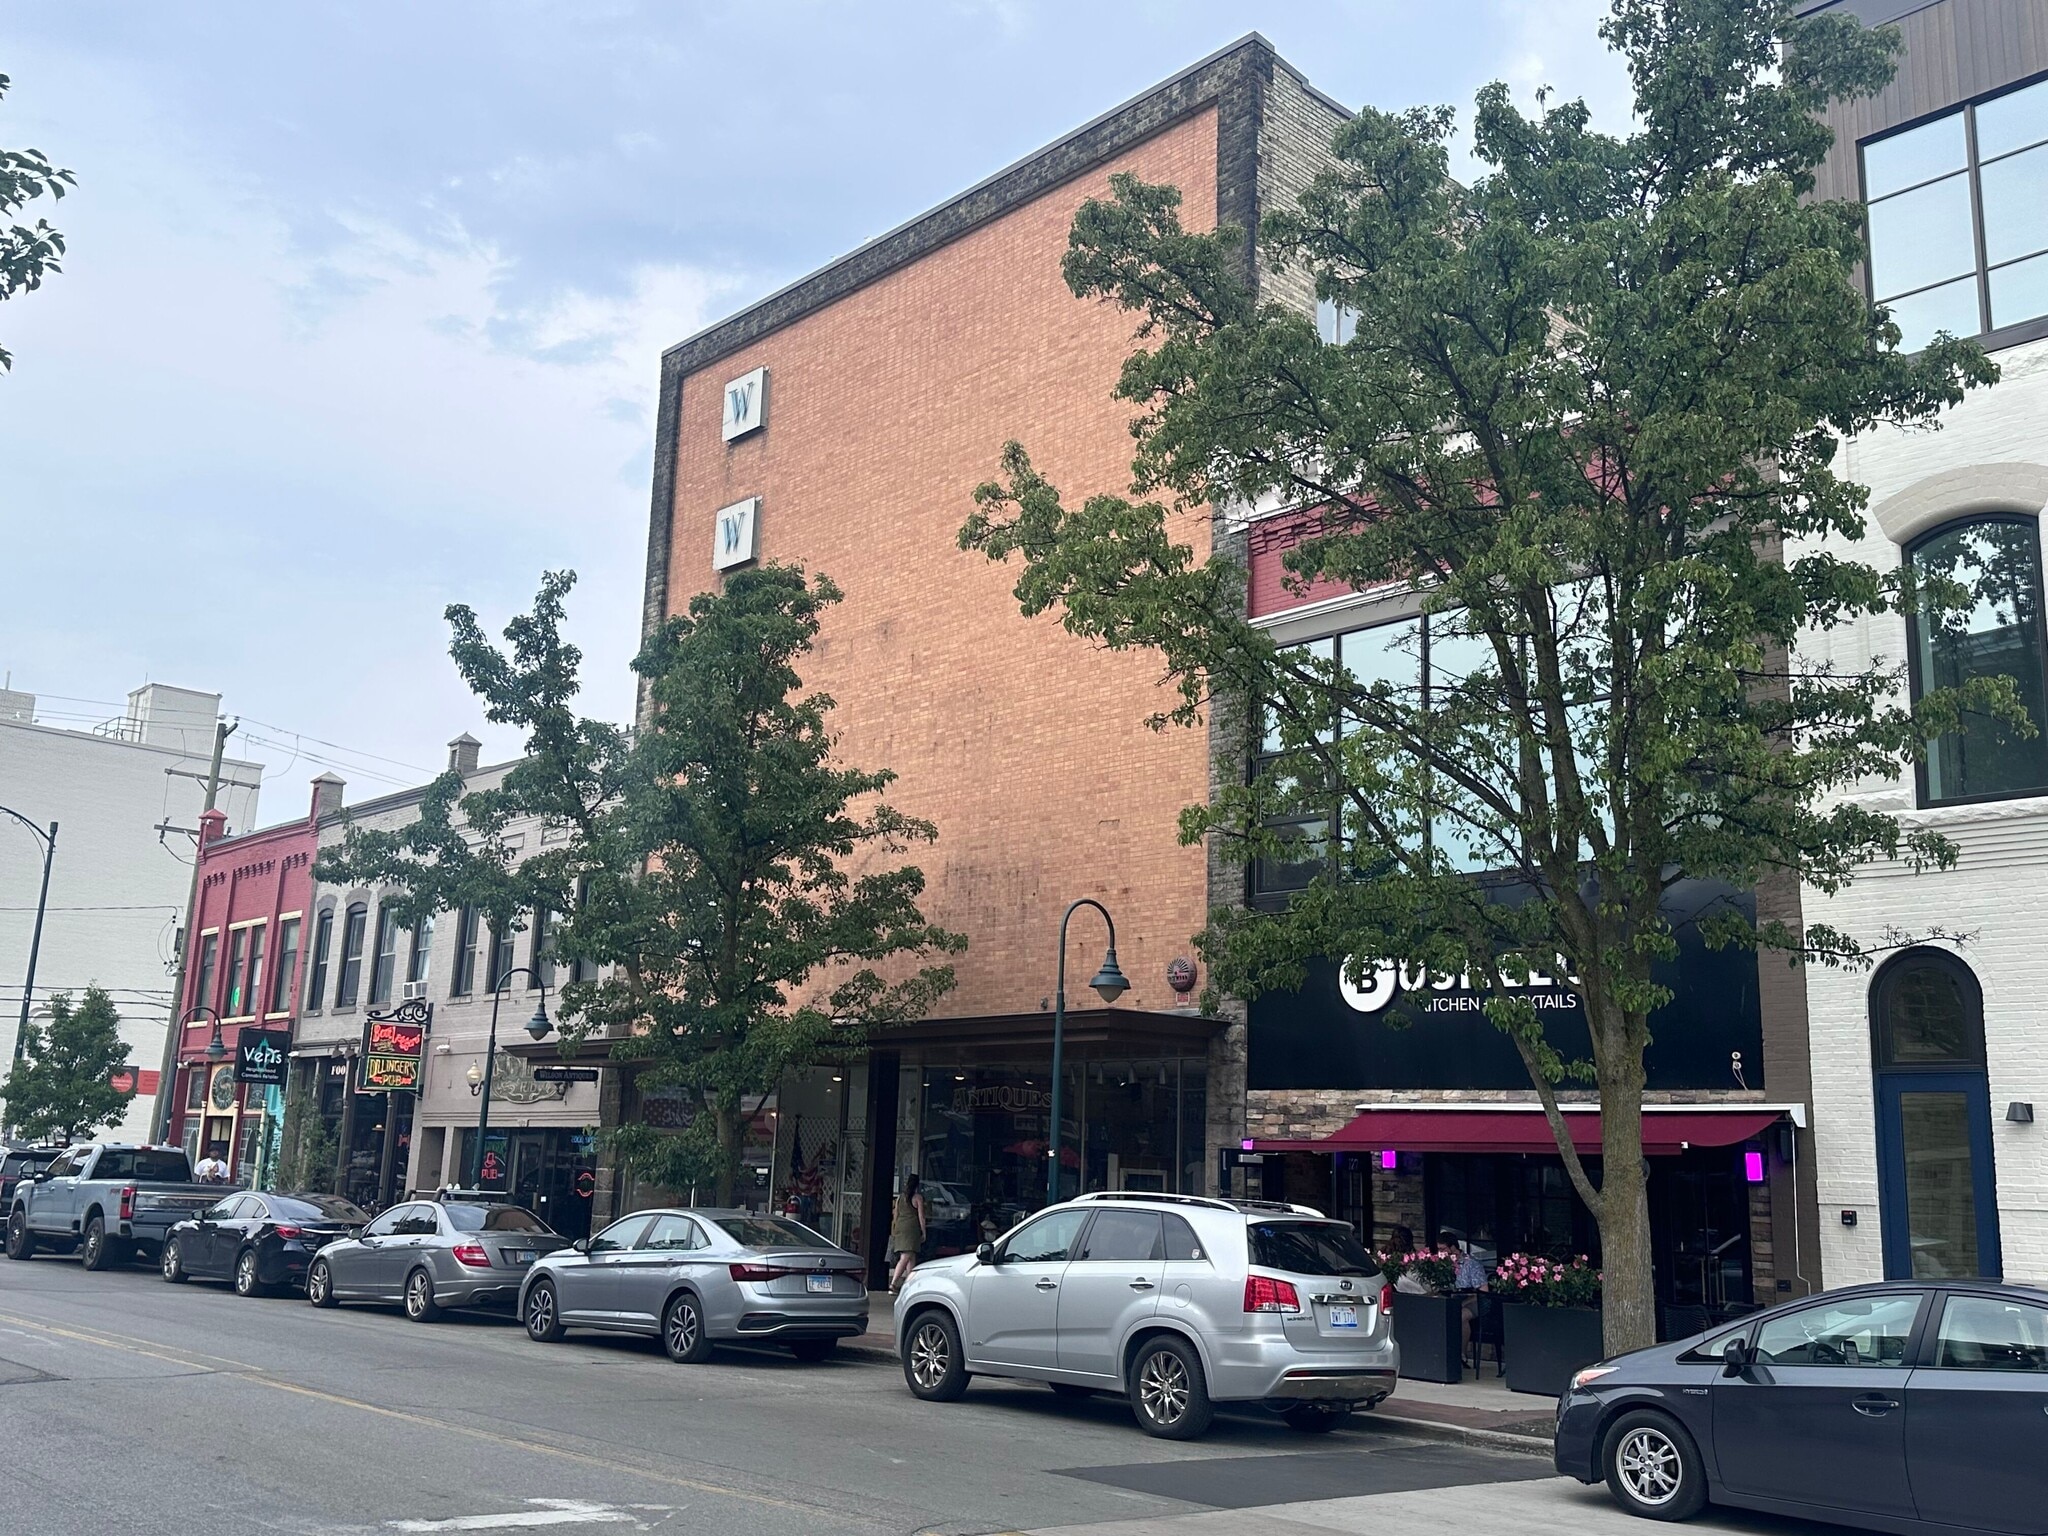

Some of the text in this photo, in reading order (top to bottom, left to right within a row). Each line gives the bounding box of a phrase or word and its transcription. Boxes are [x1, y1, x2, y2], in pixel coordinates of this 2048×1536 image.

[728, 381, 755, 425] W
[721, 511, 747, 555] W
[1424, 996, 1482, 1013] ITCHEN
[1493, 993, 1577, 1010] KTAILS
[243, 1046, 282, 1064] Verts
[381, 1074, 402, 1087] PUB
[951, 1085, 1053, 1115] ANTIQUES
